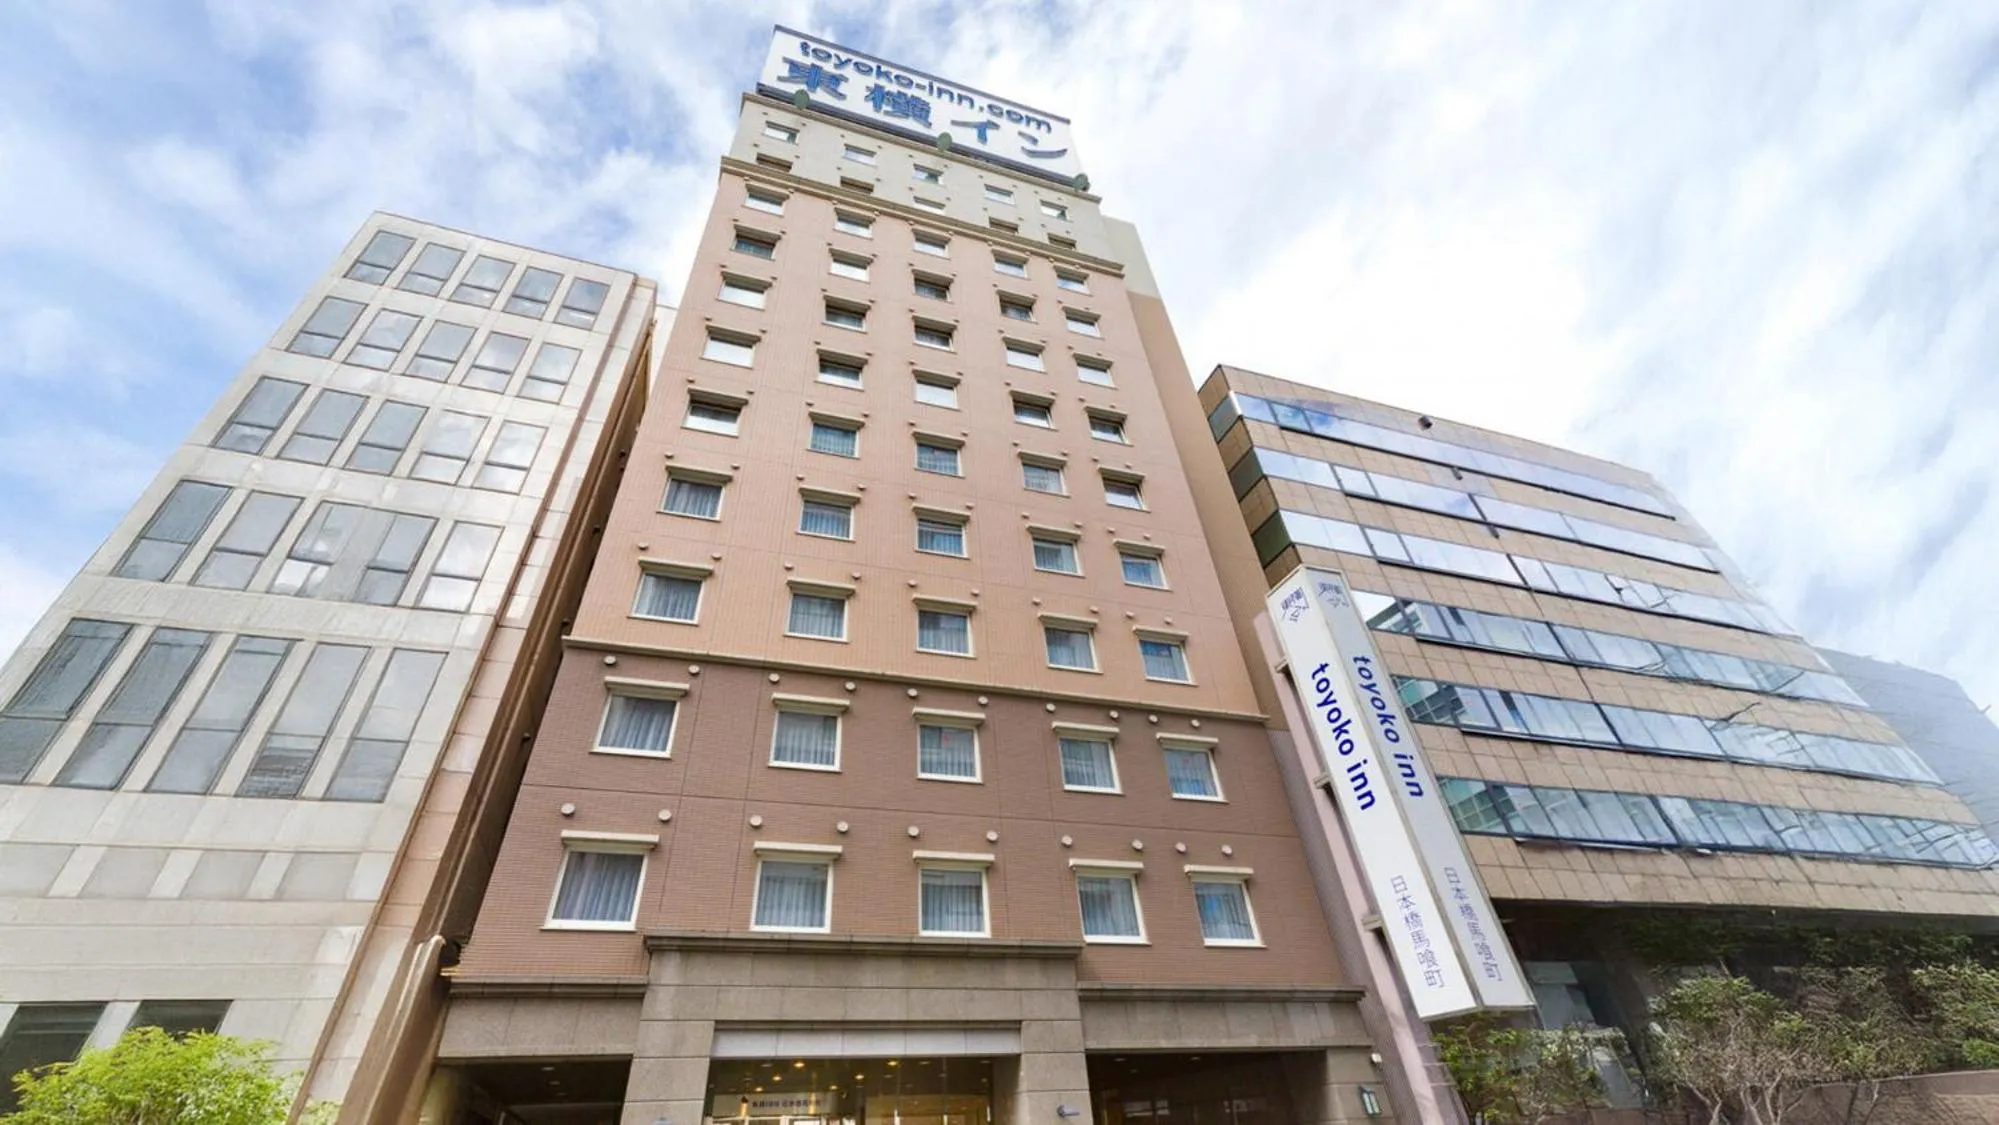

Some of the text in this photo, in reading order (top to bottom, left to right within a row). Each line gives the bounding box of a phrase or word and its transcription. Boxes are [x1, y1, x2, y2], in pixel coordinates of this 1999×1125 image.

[777, 57, 1068, 159] 東横イン
[800, 41, 1052, 134] toyoko-inn.com
[1311, 663, 1377, 810] toyoko inn
[1353, 655, 1424, 797] toyoko inn
